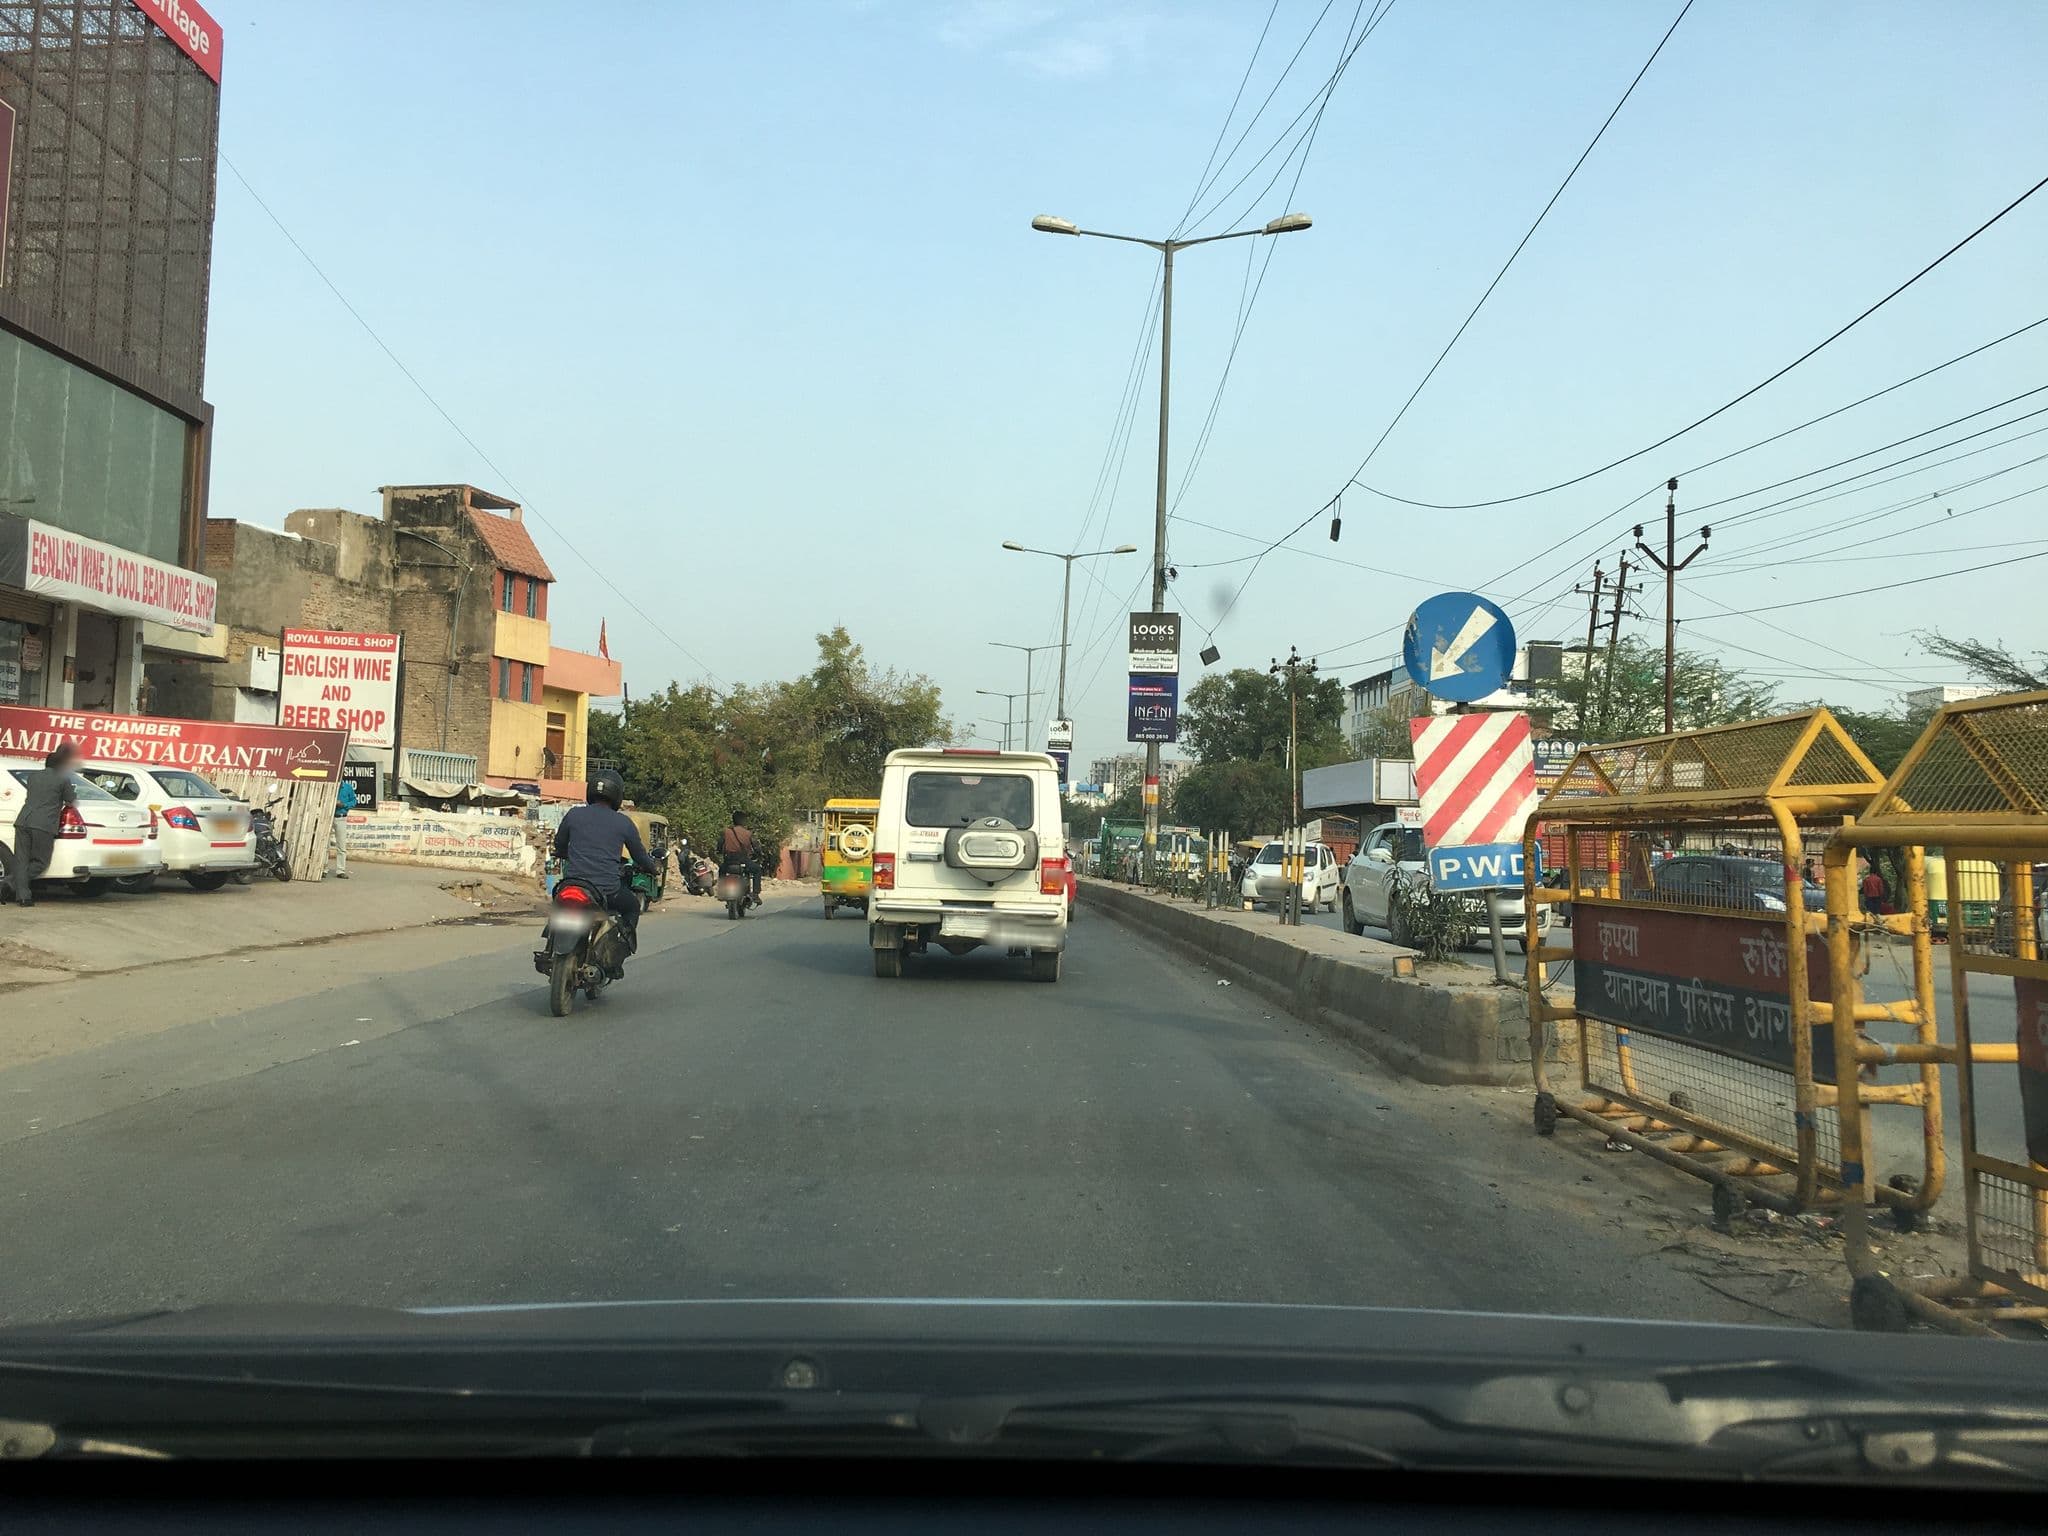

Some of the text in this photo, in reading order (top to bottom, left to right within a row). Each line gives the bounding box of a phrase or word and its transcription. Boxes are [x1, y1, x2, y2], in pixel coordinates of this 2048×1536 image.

[31, 532, 215, 621] EGNLISH WINE & COOL BEAR MODEL SHOP
[1133, 624, 1175, 635] LOOKS
[286, 633, 395, 648] ROYAL MODEL SHOP
[284, 653, 392, 682] ENGLISH WINE
[321, 684, 351, 702] AND
[48, 714, 182, 738] THE CHAMBER
[283, 704, 386, 733] BEER SHOP
[191, 765, 204, 773] BY
[252, 769, 277, 777] INDIA
[355, 766, 375, 778] WINE
[1603, 969, 1671, 1017] यातायात
[1676, 976, 1736, 1034] पुलिस
